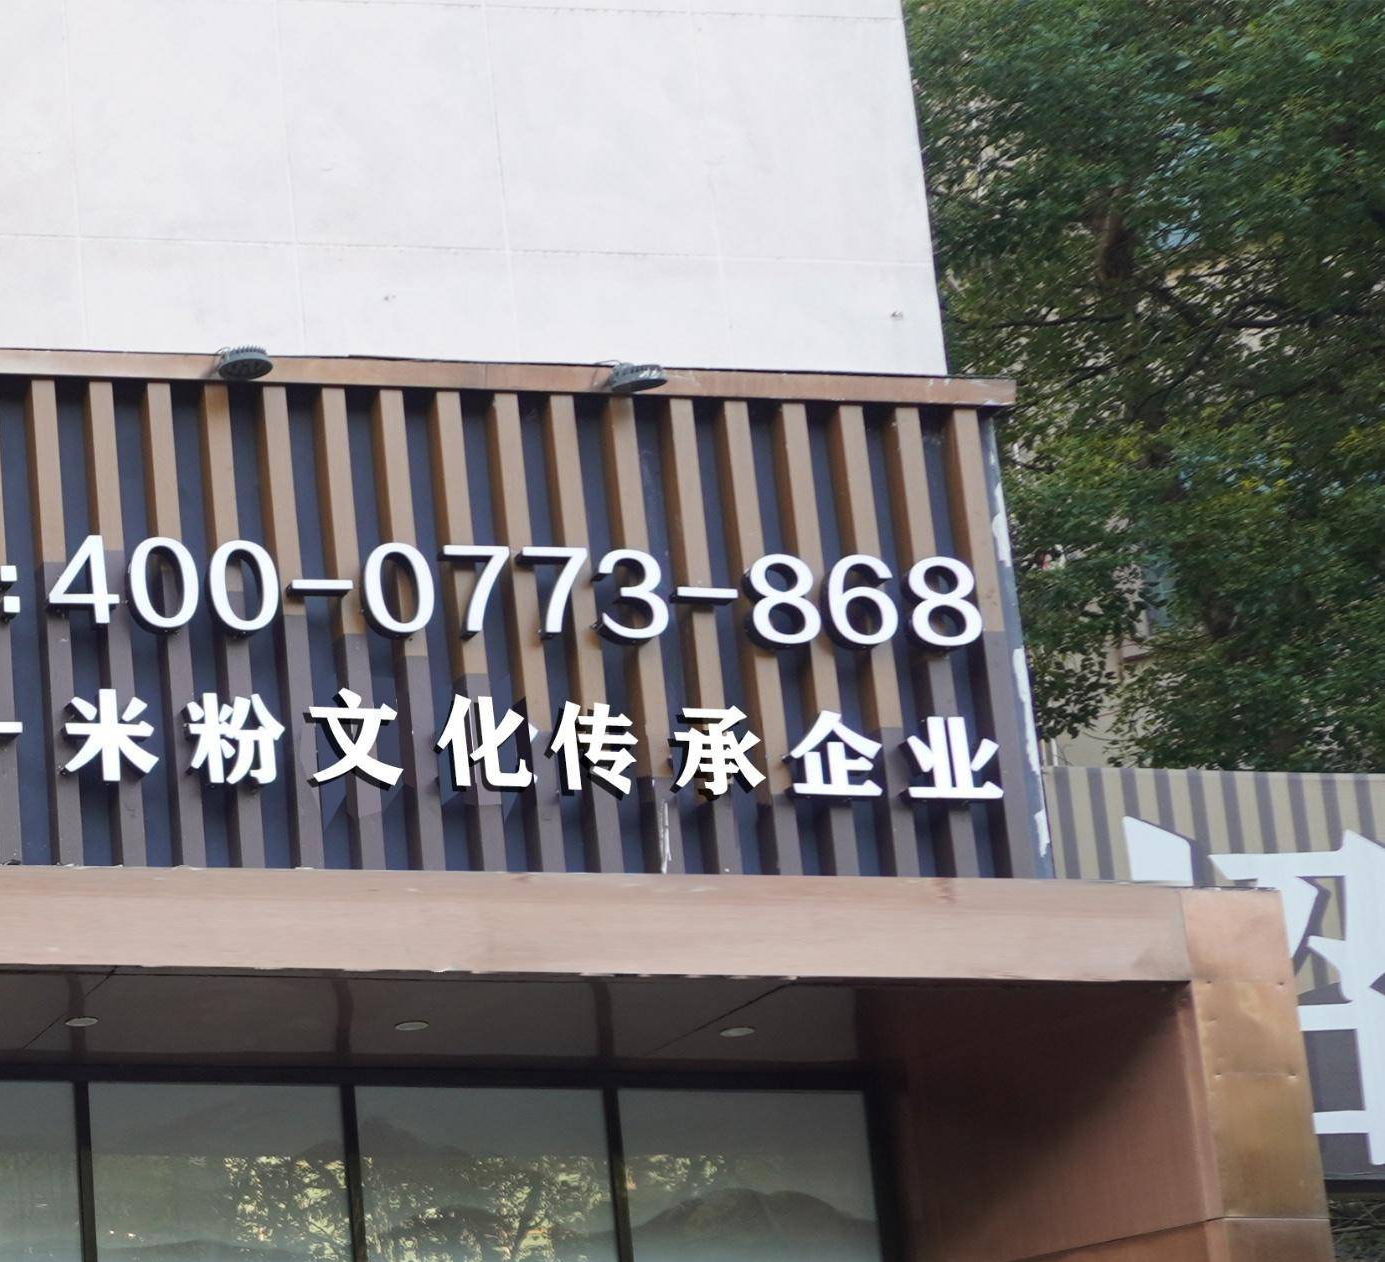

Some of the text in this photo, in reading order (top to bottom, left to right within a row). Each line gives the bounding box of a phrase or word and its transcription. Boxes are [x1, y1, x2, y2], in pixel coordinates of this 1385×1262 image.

[64, 688, 1004, 799] 米粉文化传承企业
